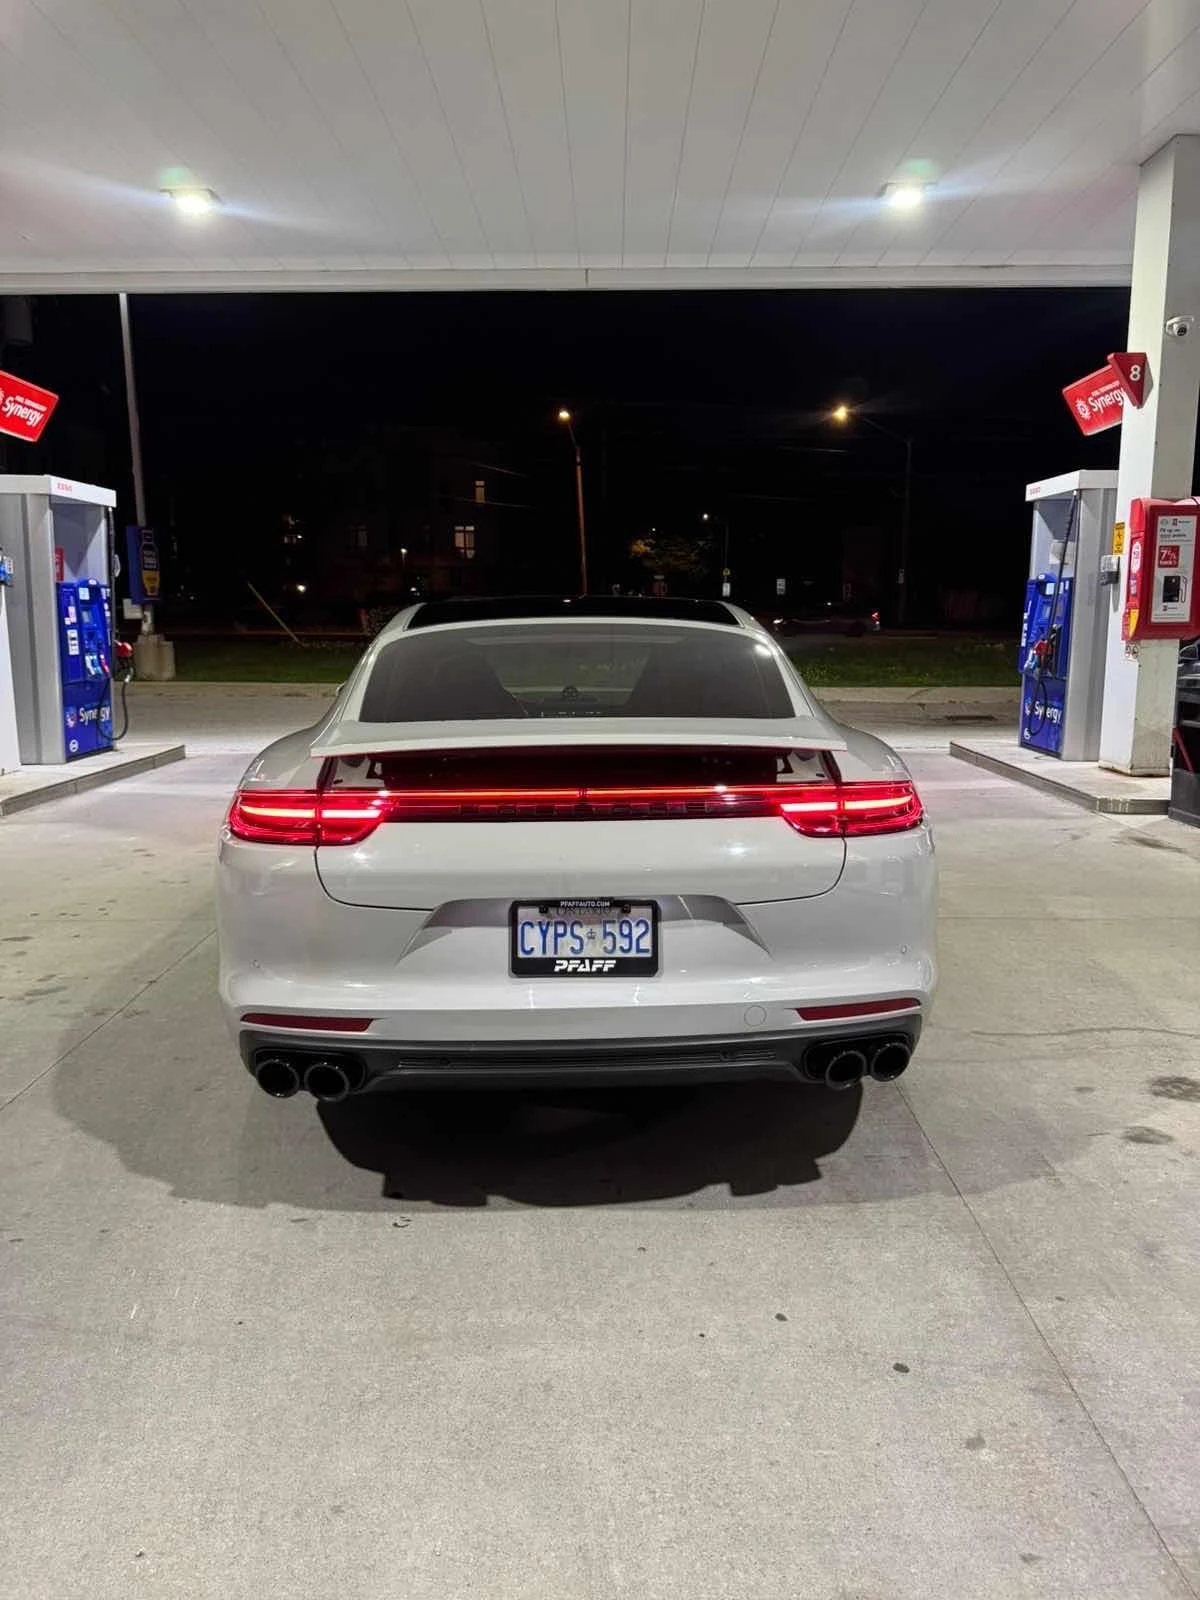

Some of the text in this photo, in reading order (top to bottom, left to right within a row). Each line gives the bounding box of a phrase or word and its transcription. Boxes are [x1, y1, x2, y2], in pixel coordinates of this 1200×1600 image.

[1129, 364, 1141, 381] 8
[1, 396, 44, 427] Synergy
[1088, 387, 1127, 414] Synergy
[79, 707, 110, 725] Synegy
[1034, 701, 1062, 724] Syergy
[520, 919, 651, 955] CYPS 592
[554, 959, 616, 973] PFAFF
